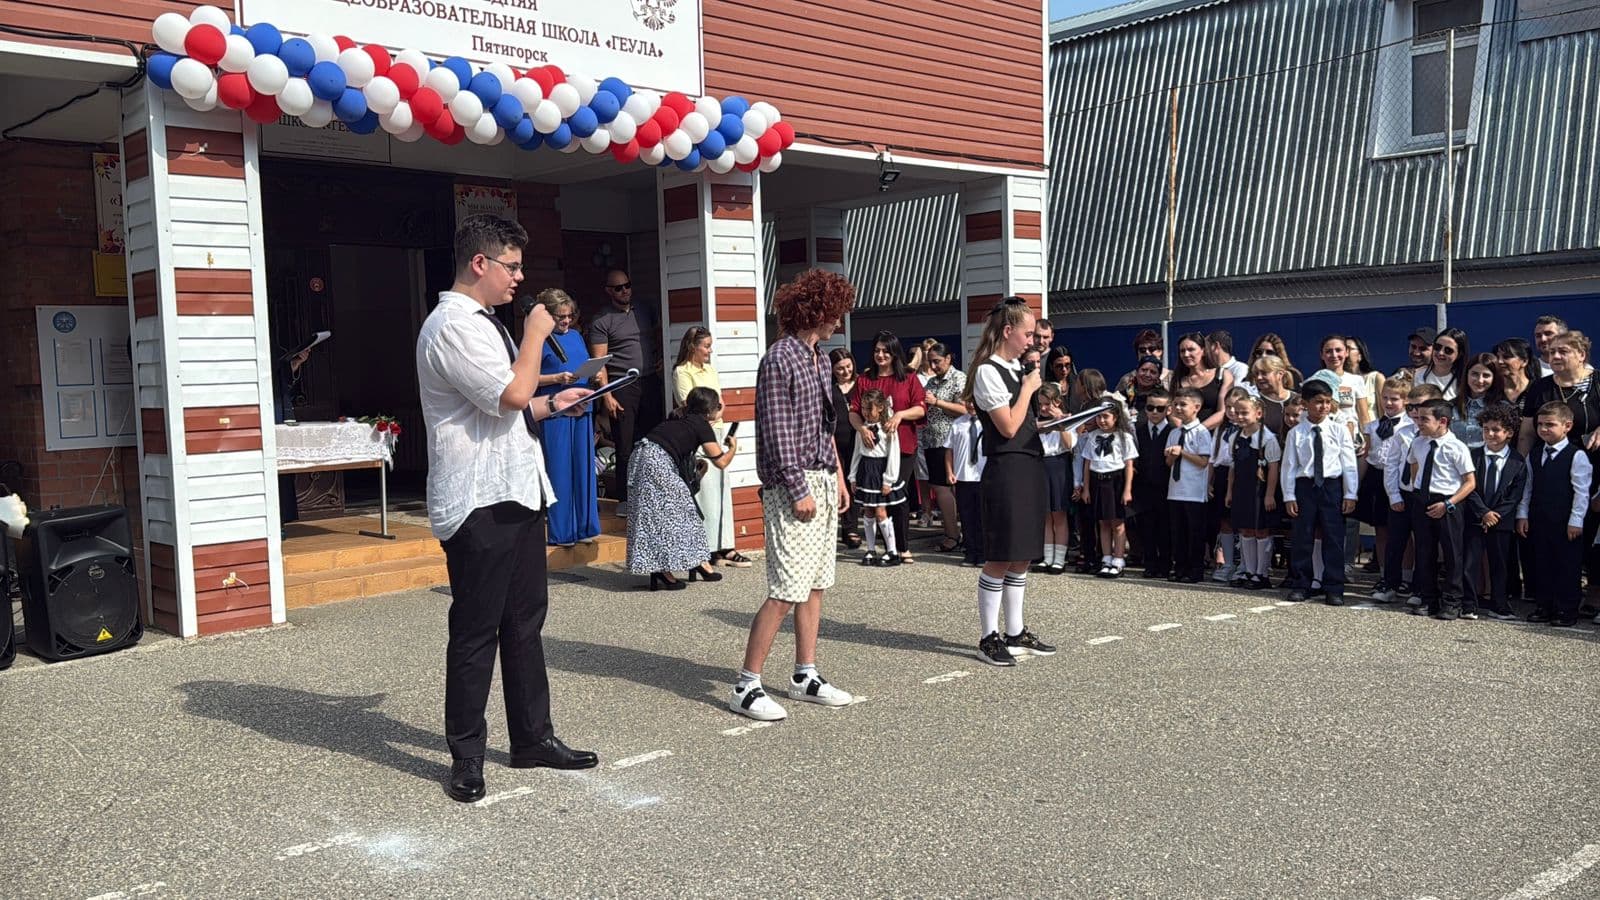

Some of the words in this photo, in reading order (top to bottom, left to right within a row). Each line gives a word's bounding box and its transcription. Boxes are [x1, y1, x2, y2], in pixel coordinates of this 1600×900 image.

[332, 0, 537, 36] ОБРАЗОВАТЕЛЬНАЯ
[541, 22, 601, 47] ШКОЛА
[605, 35, 663, 58] «ГЕУЛА»
[472, 35, 548, 63] Пятигорск
